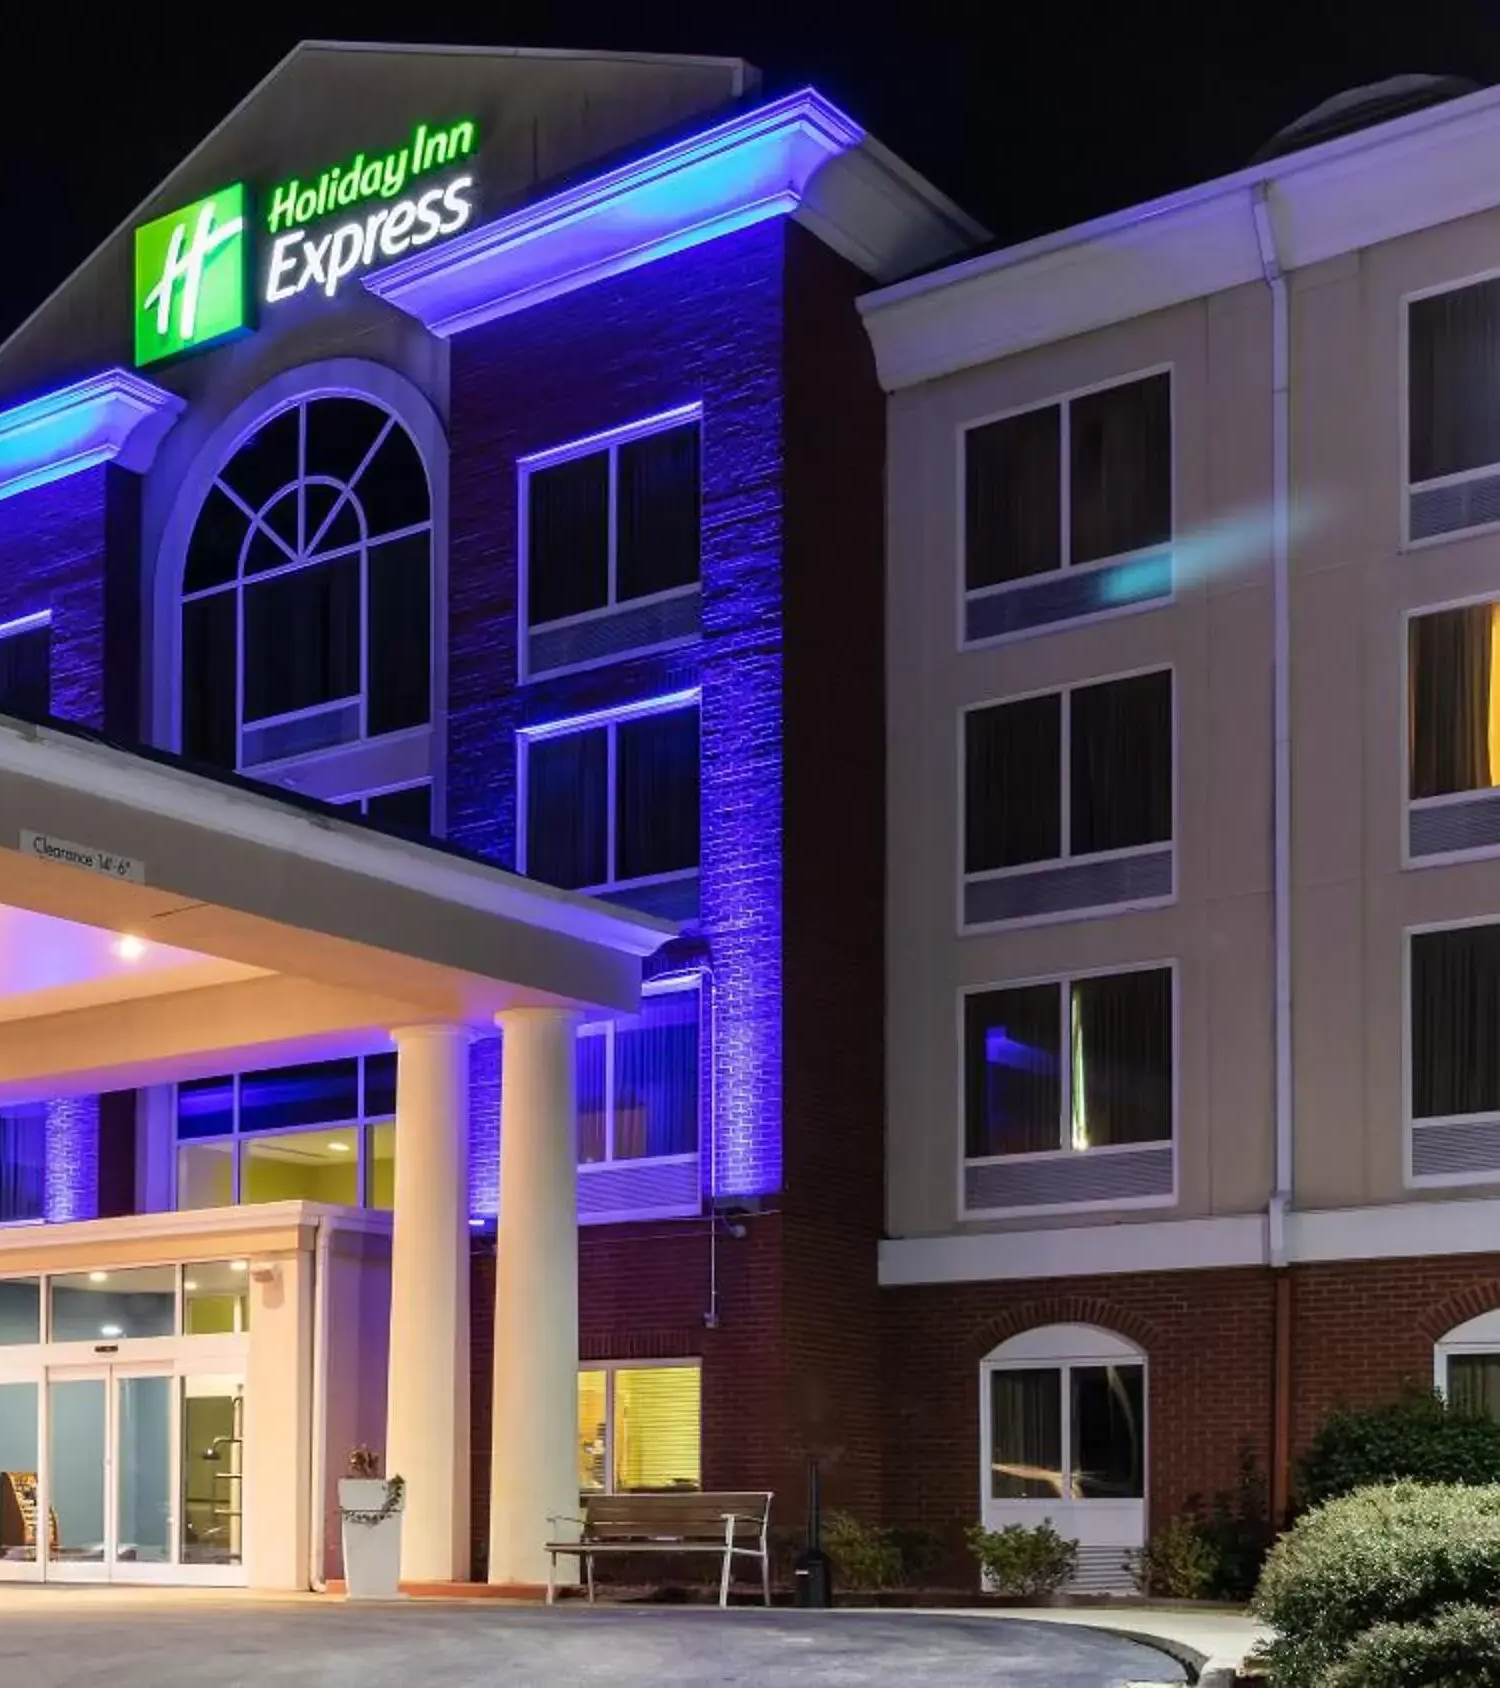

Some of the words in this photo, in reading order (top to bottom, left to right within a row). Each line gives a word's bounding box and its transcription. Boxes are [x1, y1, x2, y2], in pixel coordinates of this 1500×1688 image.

[268, 149, 409, 232] Holiday
[411, 121, 474, 174] Inn
[265, 176, 473, 303] Express
[33, 836, 93, 867] Clearance
